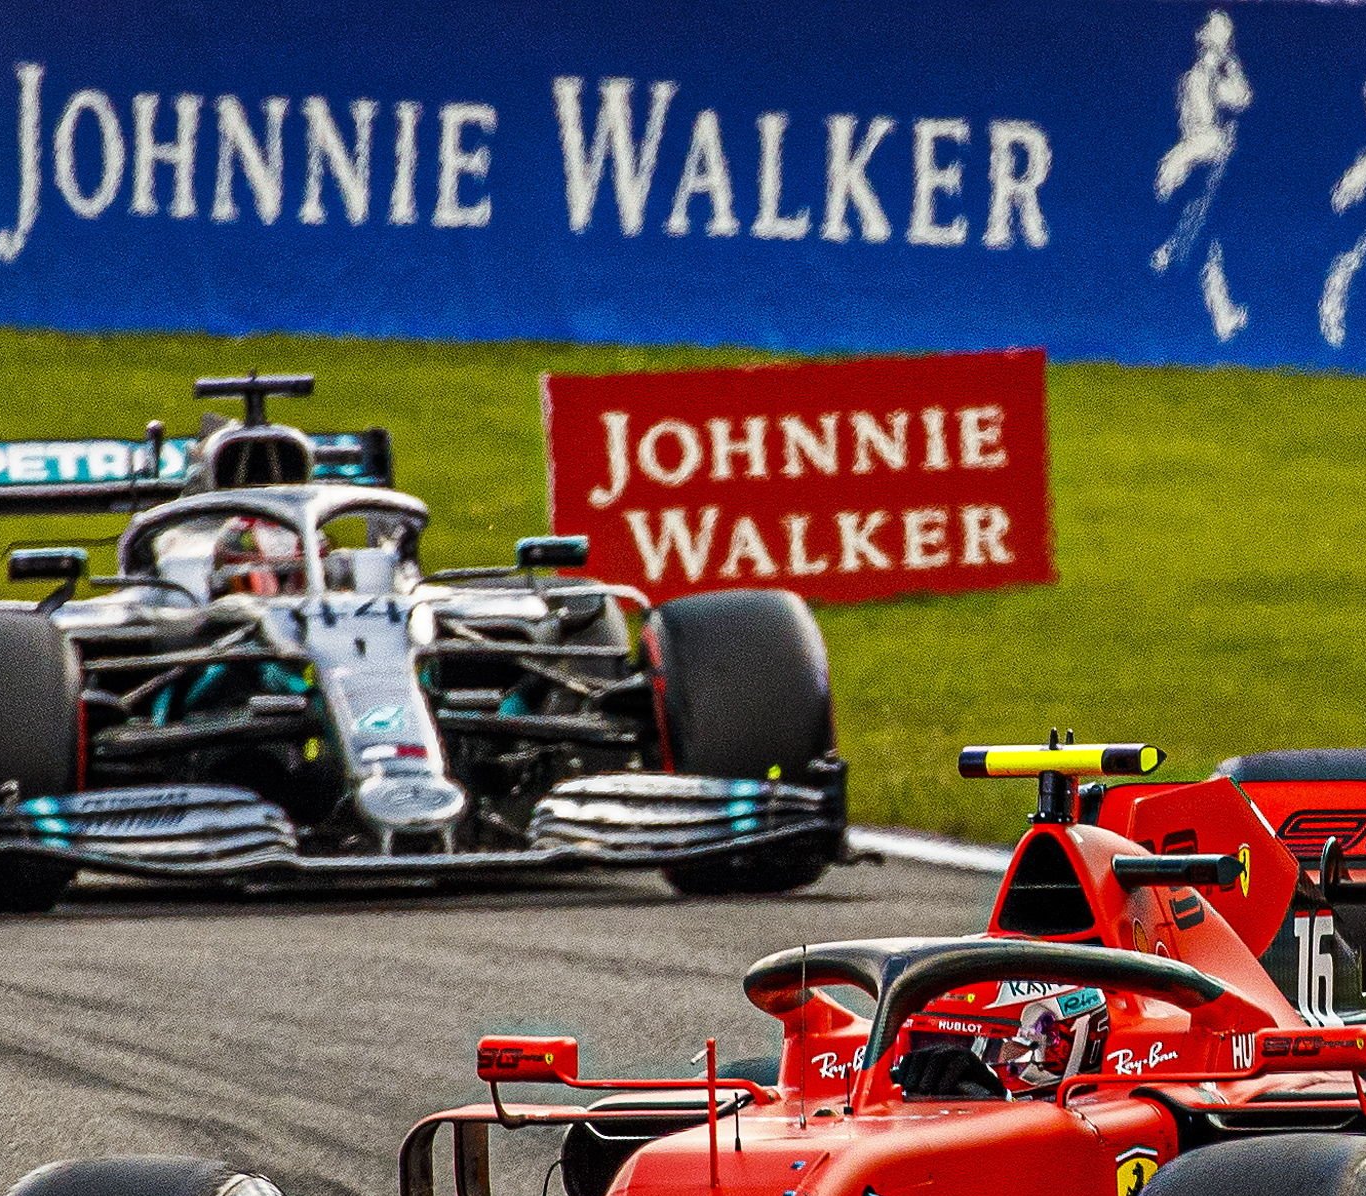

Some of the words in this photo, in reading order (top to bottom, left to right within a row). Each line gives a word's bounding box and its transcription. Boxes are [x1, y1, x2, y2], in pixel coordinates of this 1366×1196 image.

[553, 76, 1053, 249] WALKER
[588, 403, 1007, 508] JOHNNIE
[624, 504, 1015, 584] WALKER
[1294, 908, 1345, 1028] 16
[938, 1020, 983, 1034] HUBLOT
